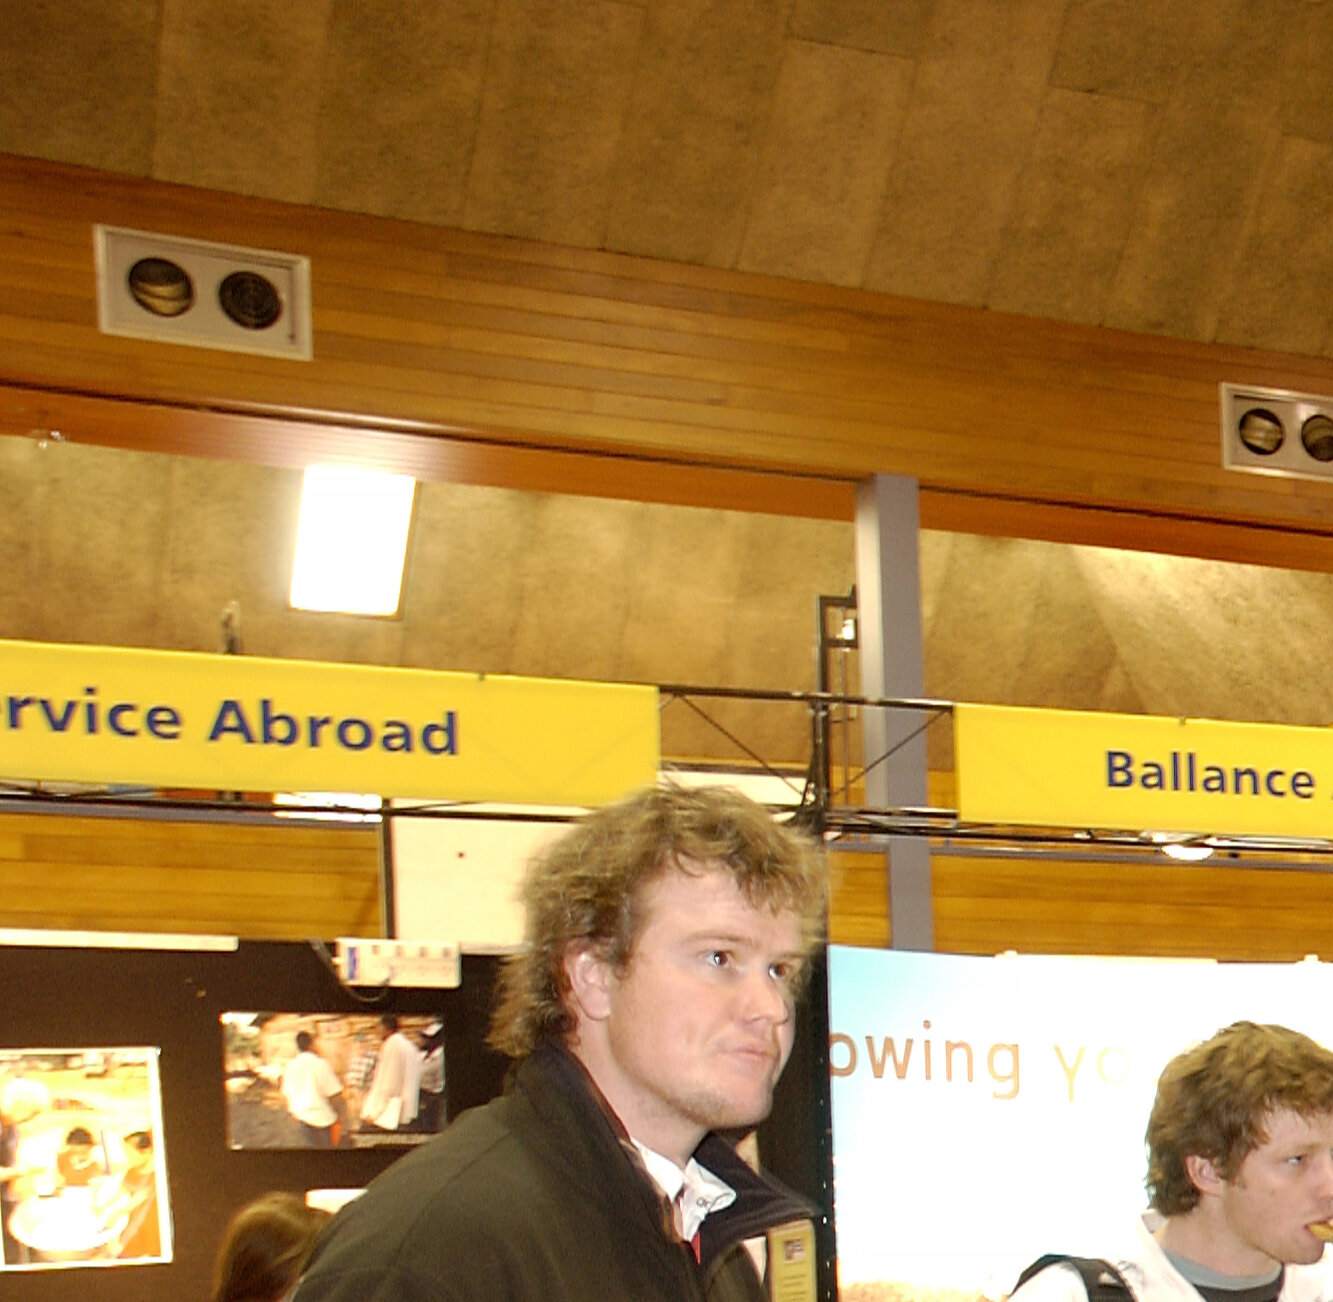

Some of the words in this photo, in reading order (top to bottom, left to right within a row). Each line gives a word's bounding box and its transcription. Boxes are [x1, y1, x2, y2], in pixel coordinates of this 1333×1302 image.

[0, 687, 182, 740] rvice
[207, 698, 458, 756] Abroad
[1105, 750, 1316, 799] Ballance
